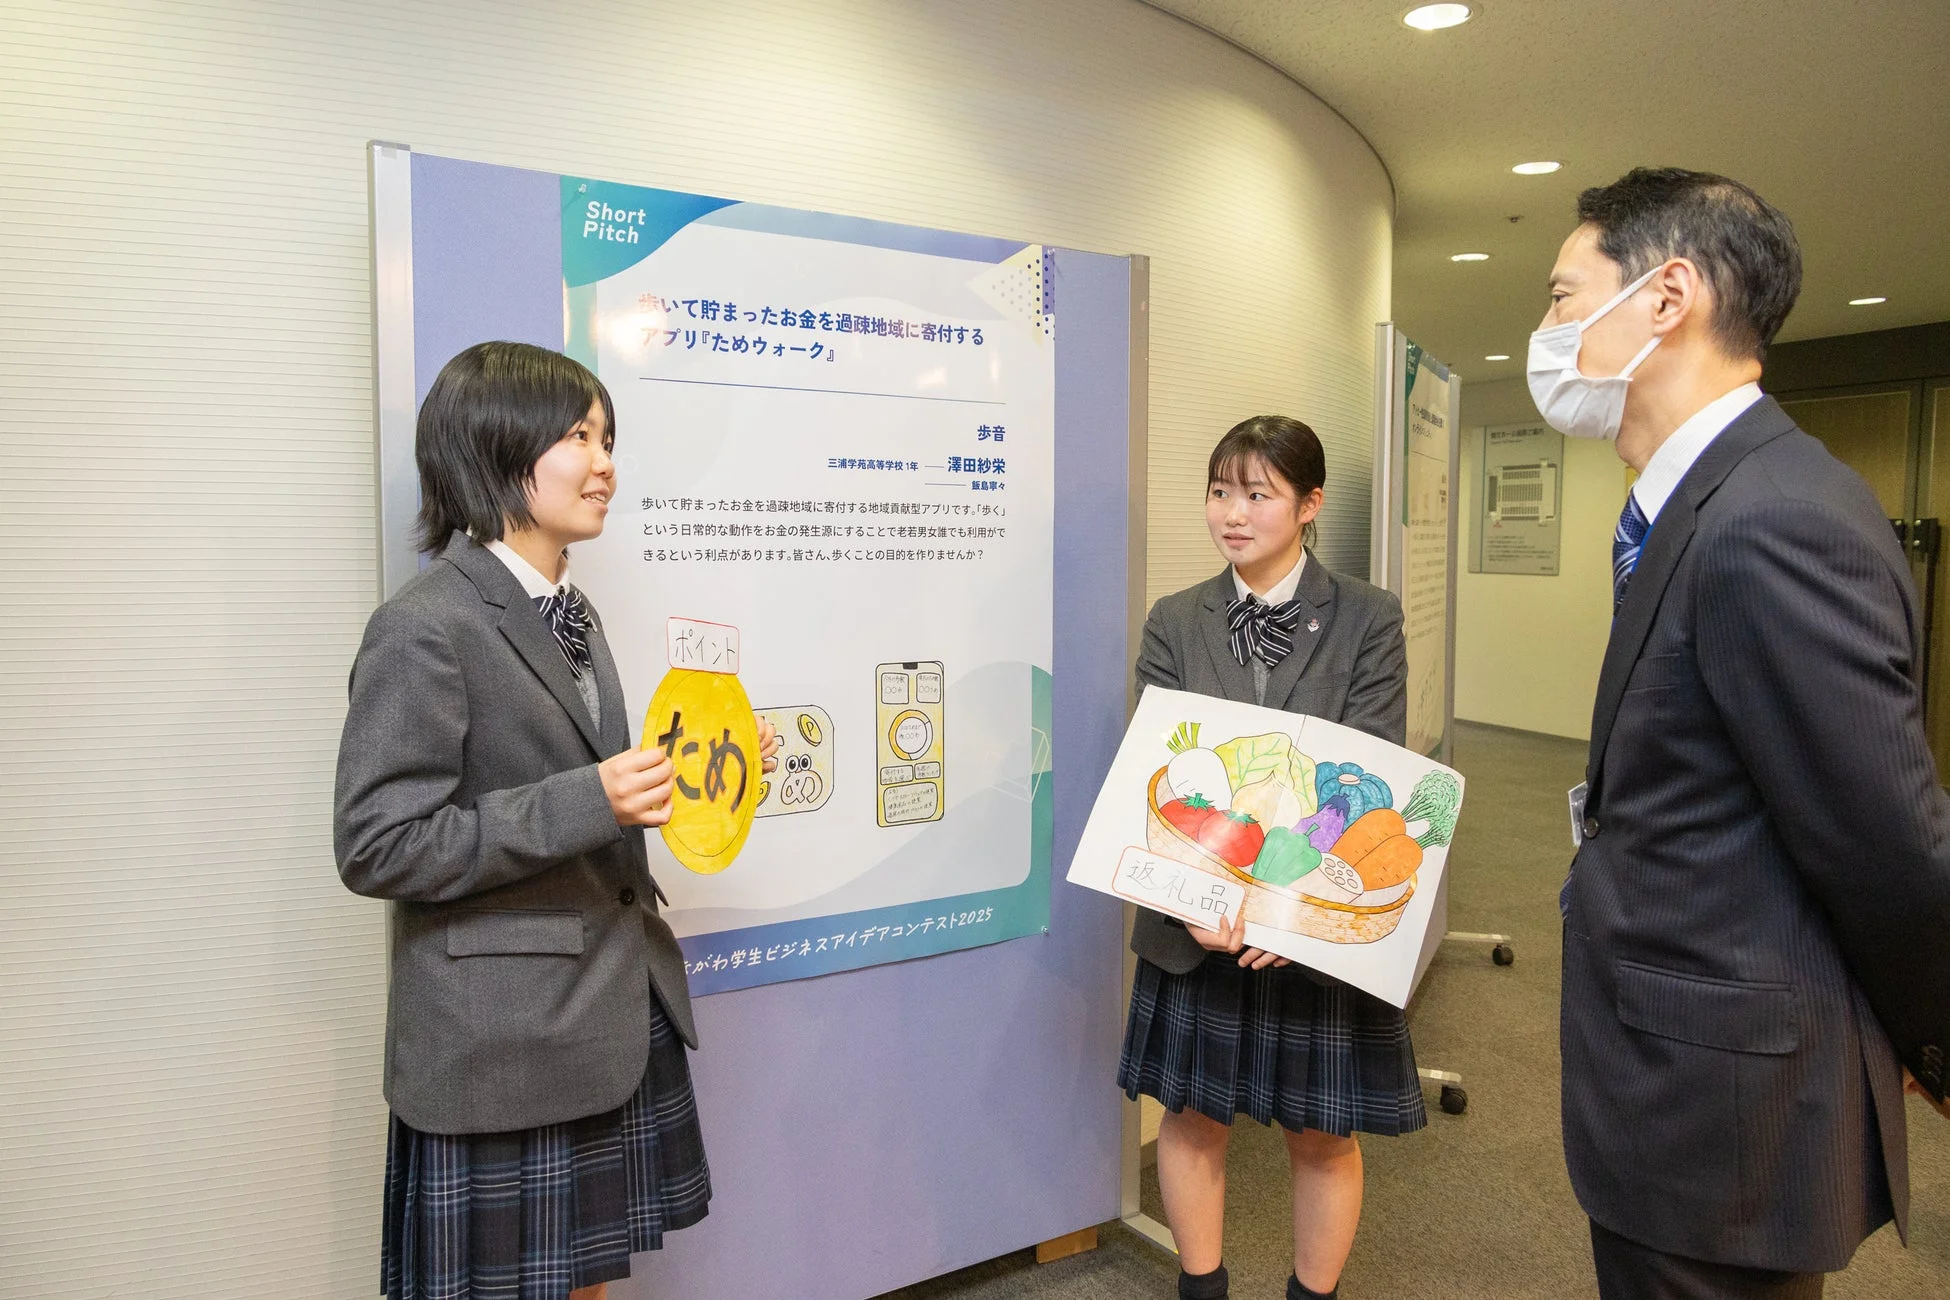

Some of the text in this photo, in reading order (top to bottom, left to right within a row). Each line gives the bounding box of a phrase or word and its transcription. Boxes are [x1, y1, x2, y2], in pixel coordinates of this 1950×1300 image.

[586, 201, 647, 226] Short
[583, 220, 639, 244] Pitch
[639, 293, 984, 346] 歩いて貯まったお金を過疎地域に寄付する
[641, 327, 835, 362] アプリ『ためウォーク』
[977, 424, 1006, 442] 歩音
[828, 456, 1006, 474] 三浦学苑高等学校 1年 澤田紗栄
[641, 497, 1006, 516] 歩いて貯まったお金を過疎地域に寄付する地域貢献型アプリです。「歩く」
[643, 523, 1006, 539] という日常的な動作をお金の発生源にすることで老若男女誰でも利用がで
[675, 628, 736, 665] ポイント
[658, 711, 748, 815] ため
[1127, 860, 1229, 915] 返礼品
